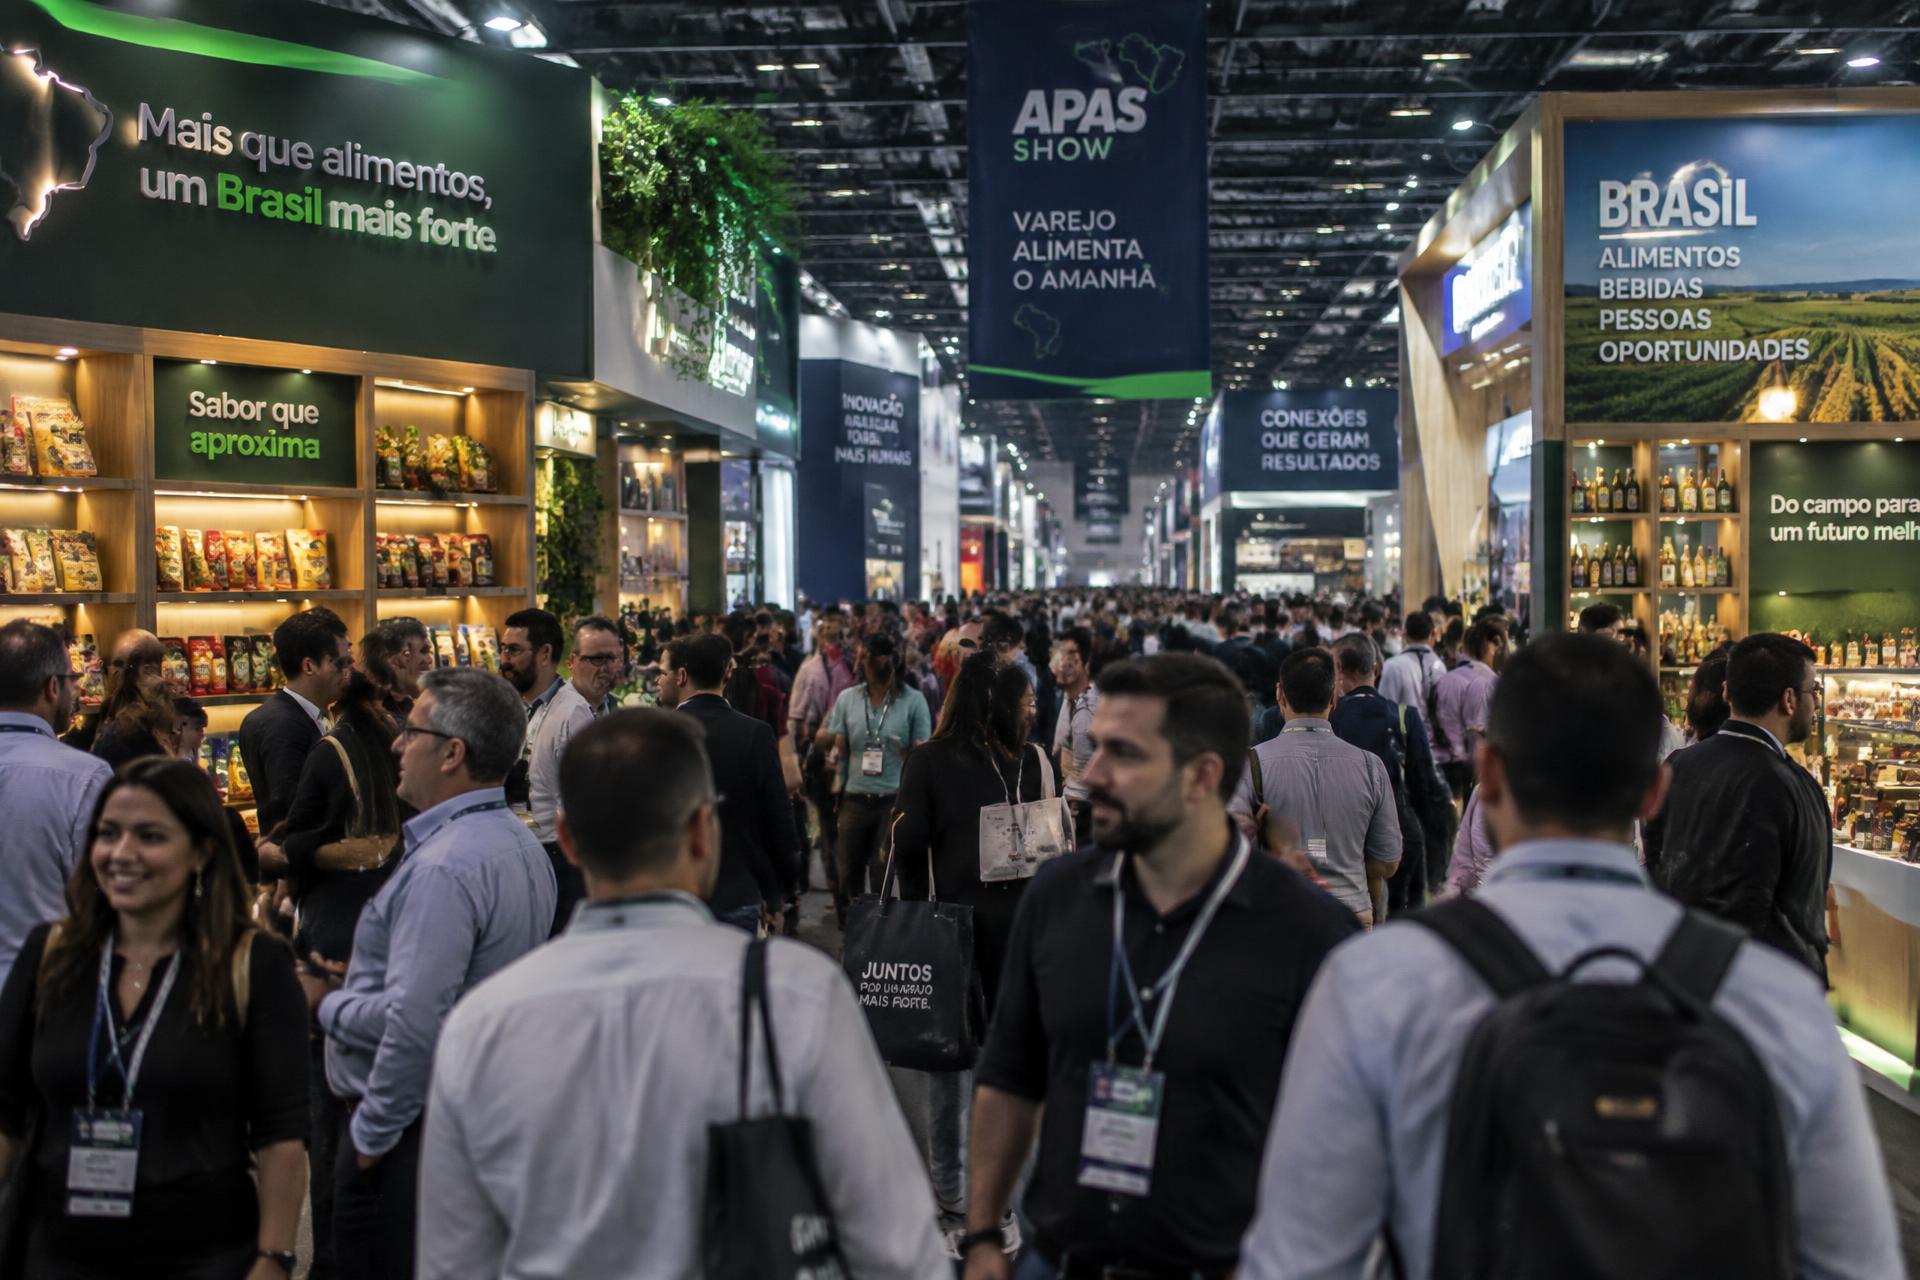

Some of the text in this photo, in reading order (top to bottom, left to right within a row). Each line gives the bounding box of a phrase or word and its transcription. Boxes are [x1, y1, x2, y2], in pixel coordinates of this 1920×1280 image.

[1013, 87, 1147, 135] APAS
[138, 102, 492, 210] Mais que alimentos,
[1013, 137, 1113, 162] SHOW
[140, 167, 496, 252] um Brasil mais forte
[1600, 178, 1757, 228] BRASIL
[1012, 210, 1116, 232] VAREJO
[1012, 239, 1144, 262] ALIMENTA
[1599, 246, 1741, 269] ALIMENTOS
[1013, 269, 1033, 290] O
[1600, 277, 1703, 300] BEBIDAS
[1600, 308, 1712, 330] PESSOAS
[1600, 338, 1810, 363] OPORTUNIDADES
[189, 390, 319, 430] Sabor que
[190, 429, 320, 460] aproxima
[1303, 431, 1370, 449] GERAM
[1261, 453, 1381, 471] RESULTADOS
[1770, 494, 1920, 518] Do campo para
[1770, 521, 1920, 541] um futuro melh
[862, 961, 932, 982] JUNTOS
[858, 994, 889, 1007] MAIS
